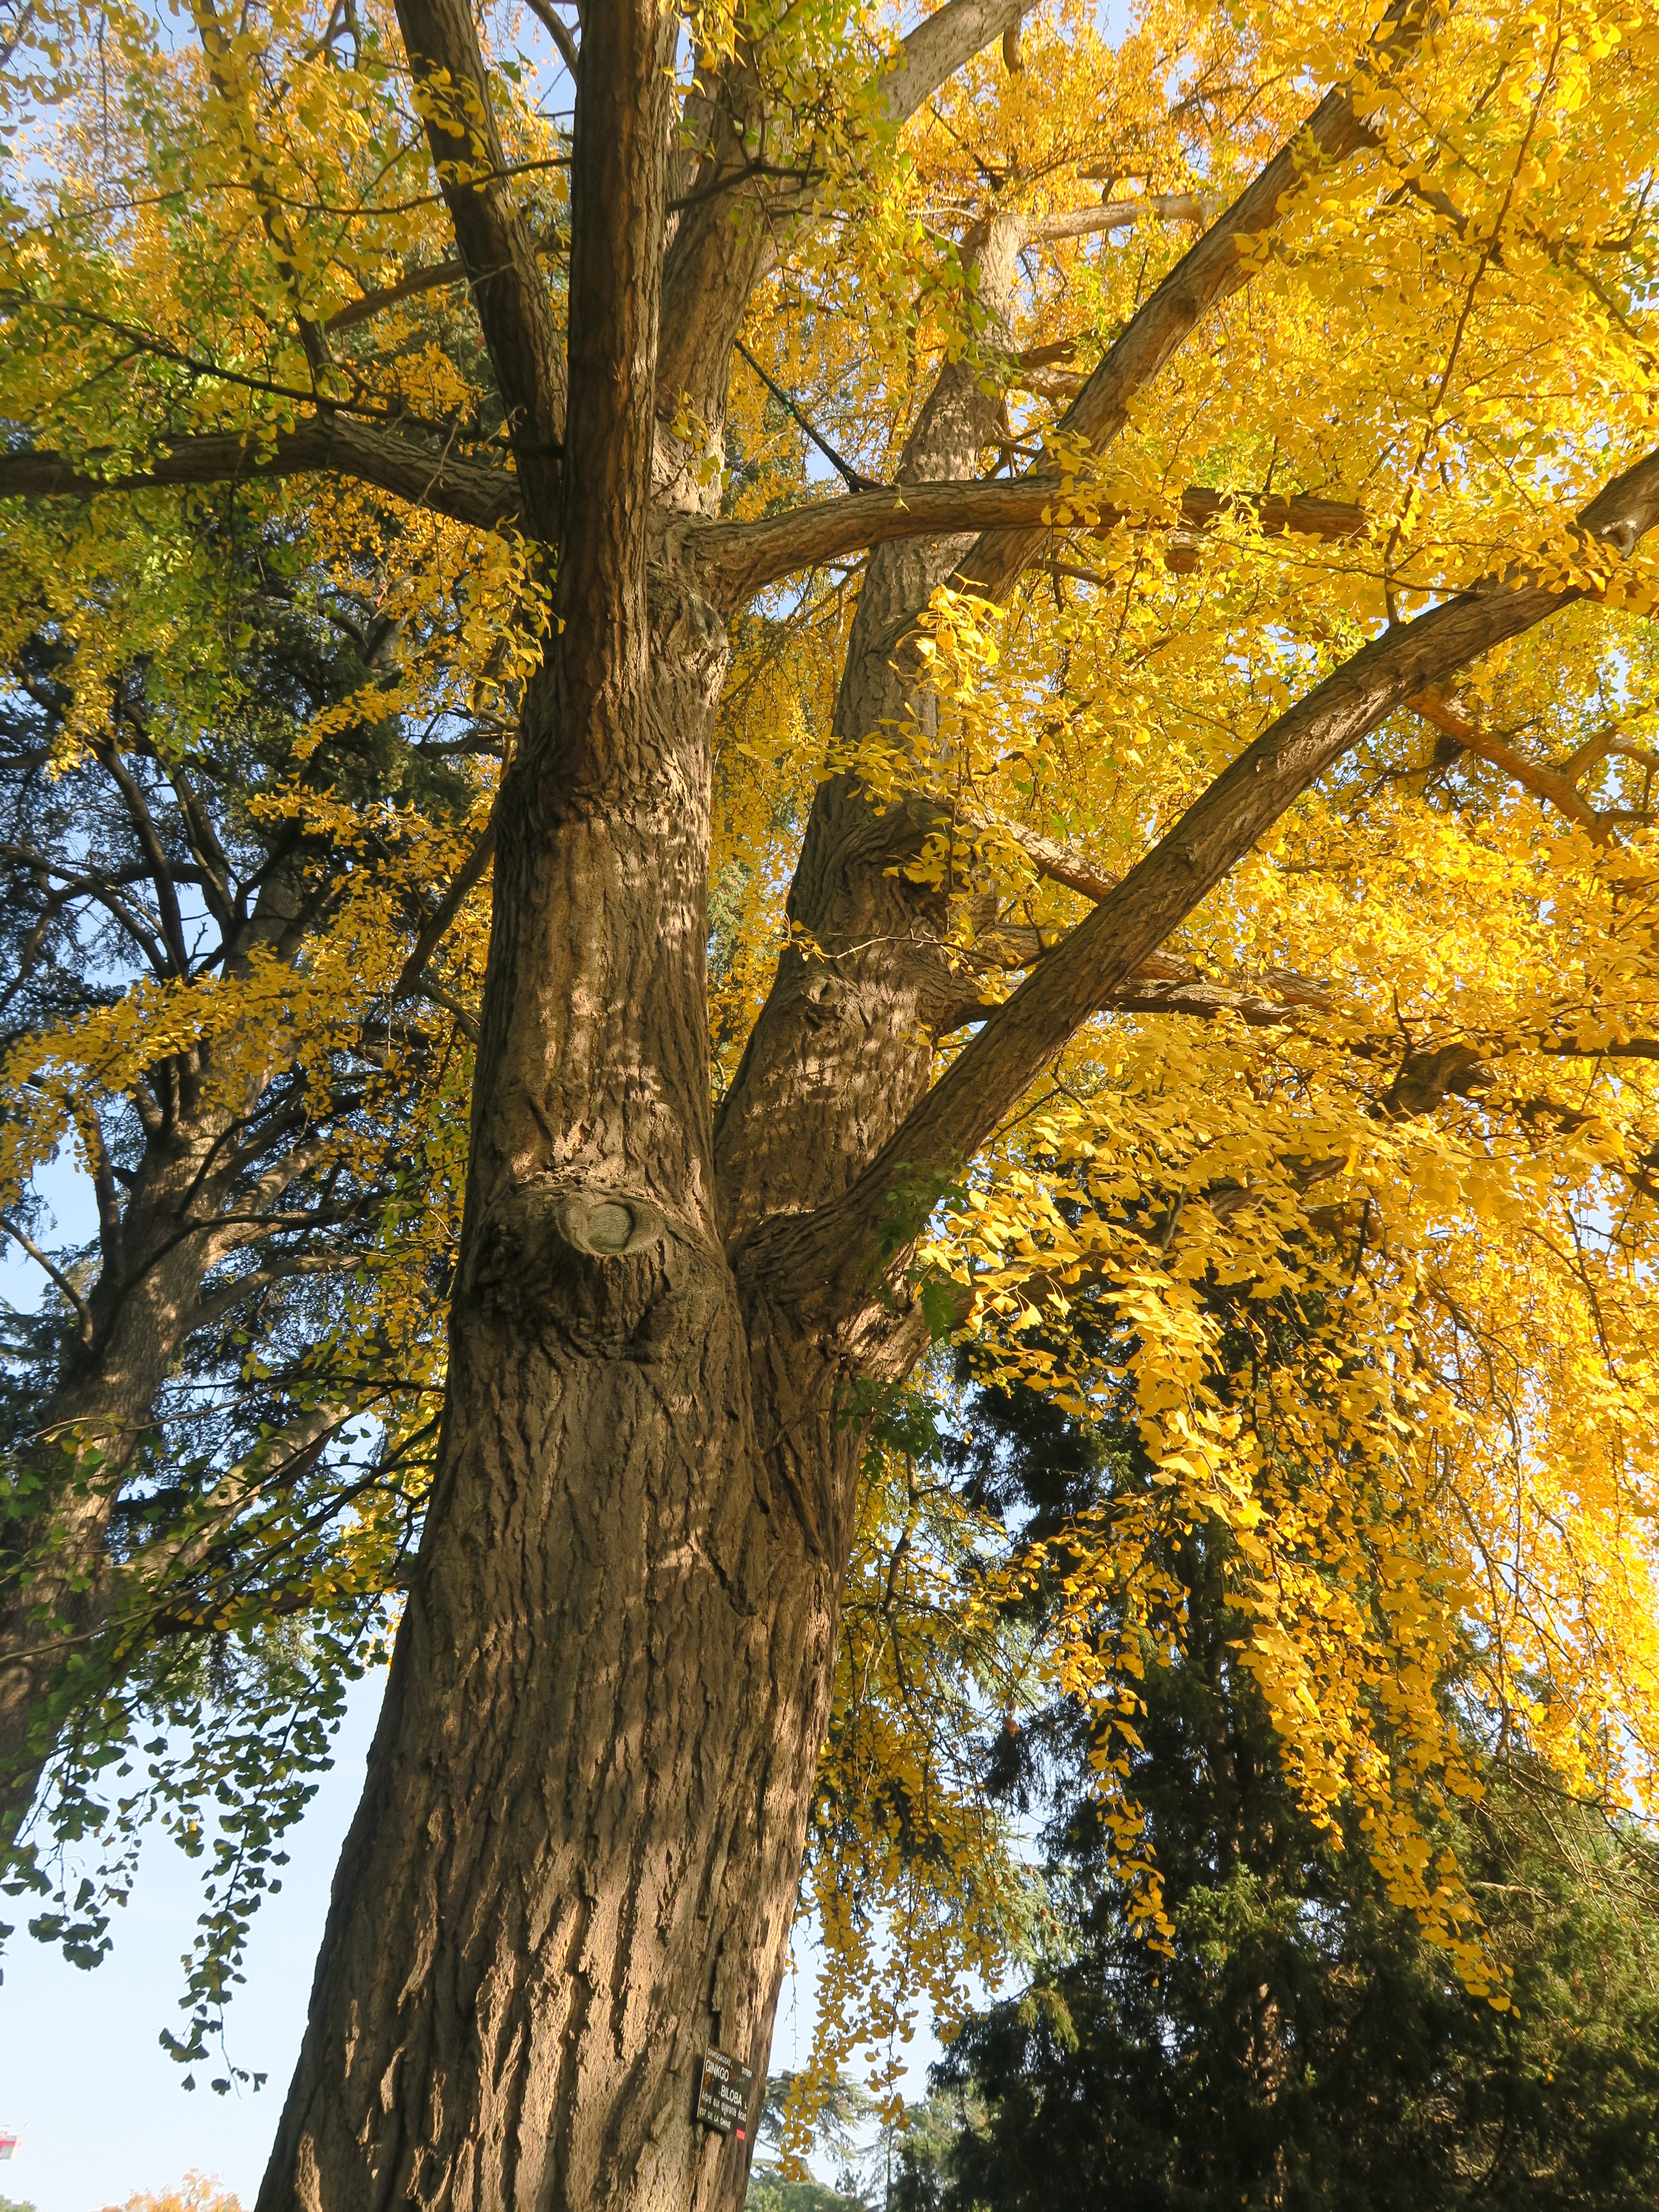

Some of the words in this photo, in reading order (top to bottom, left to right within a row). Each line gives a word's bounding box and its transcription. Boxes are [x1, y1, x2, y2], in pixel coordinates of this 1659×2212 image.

[705, 2059, 729, 2082] GINKGO
[701, 2091, 712, 2104] Arbre
[721, 2085, 742, 2107] BILOBA
[707, 2111, 713, 2120] DE
[714, 2115, 719, 2123] LA
[720, 2117, 731, 2130] CHINE
